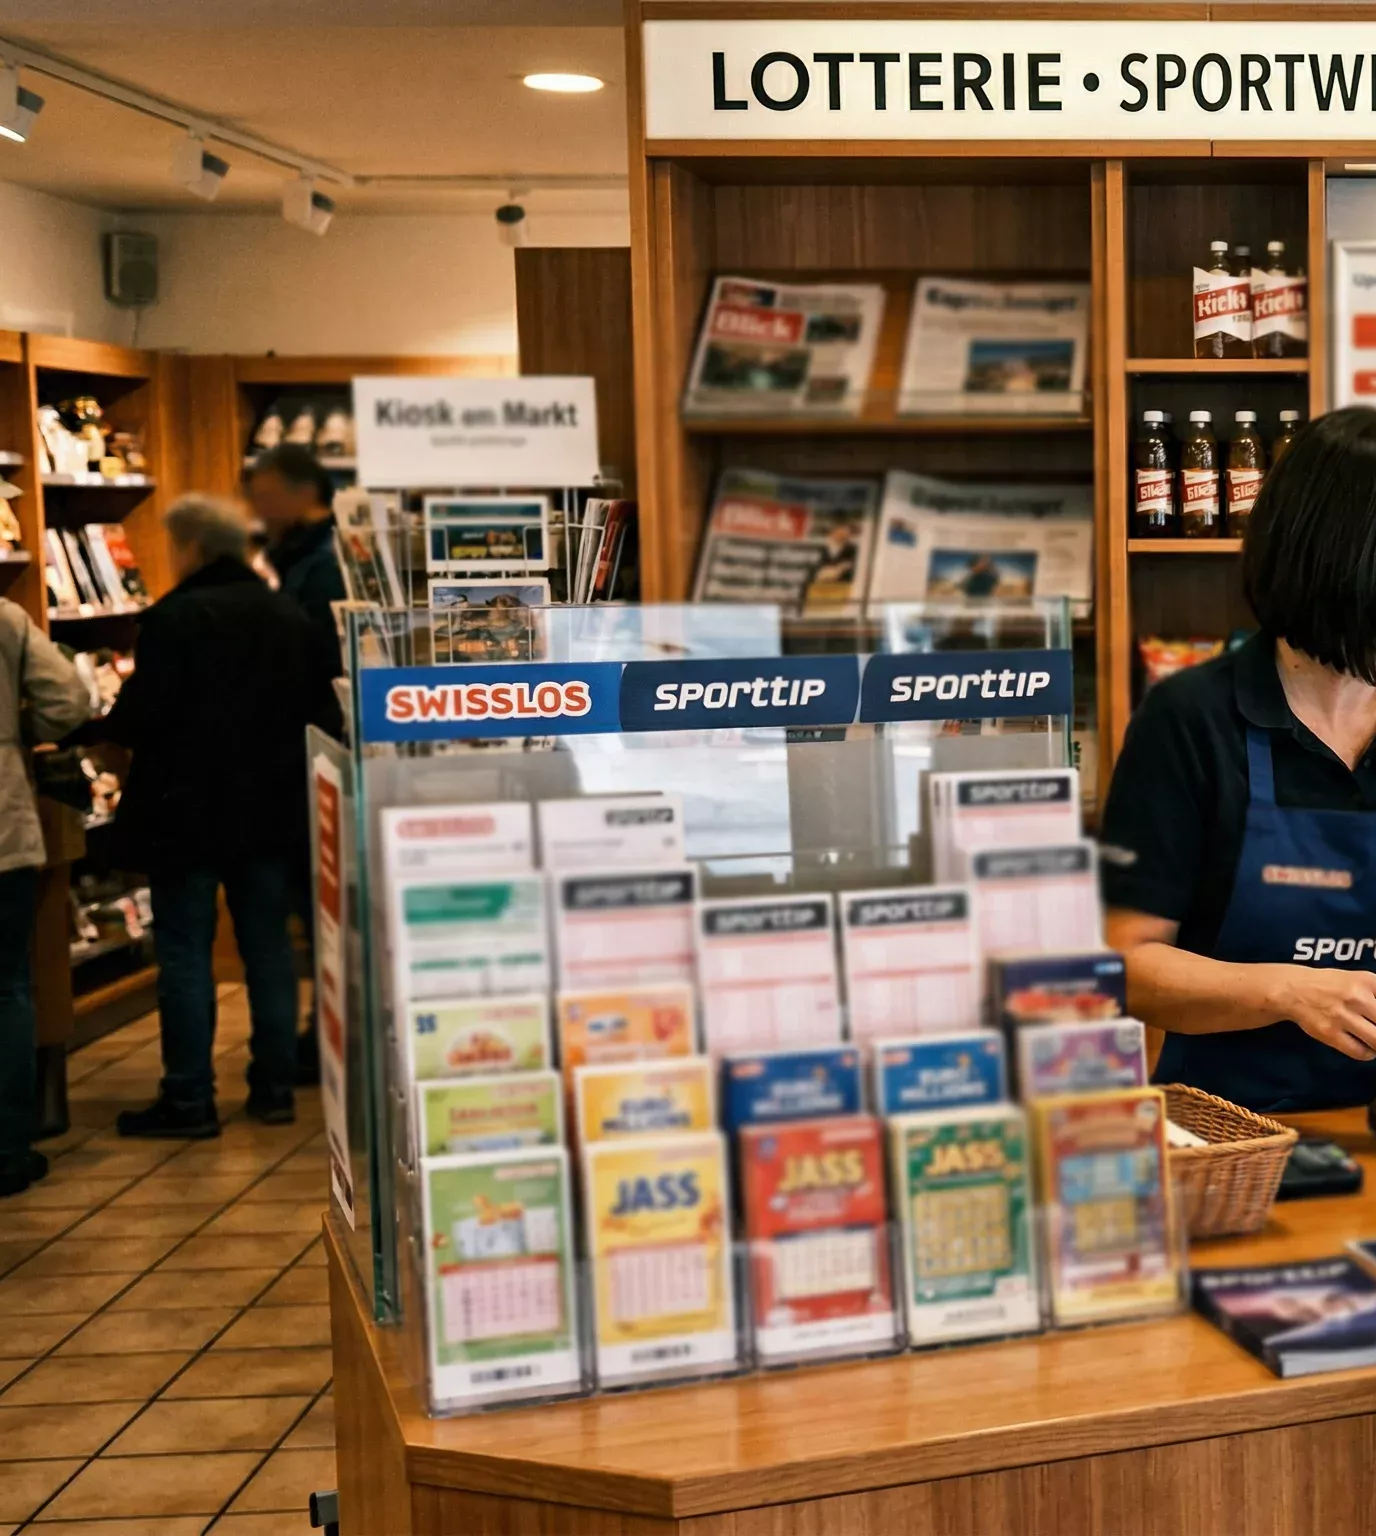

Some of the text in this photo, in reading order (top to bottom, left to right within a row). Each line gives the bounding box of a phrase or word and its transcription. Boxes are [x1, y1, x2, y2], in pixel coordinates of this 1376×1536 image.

[712, 51, 1063, 111] LOTTERIE
[375, 398, 453, 428] Kiosk
[502, 398, 578, 428] Markt
[386, 681, 592, 722] SWISSLOS
[778, 1148, 866, 1193] JASS
[923, 1139, 1005, 1177] JASS
[612, 1169, 701, 1216] JASS
